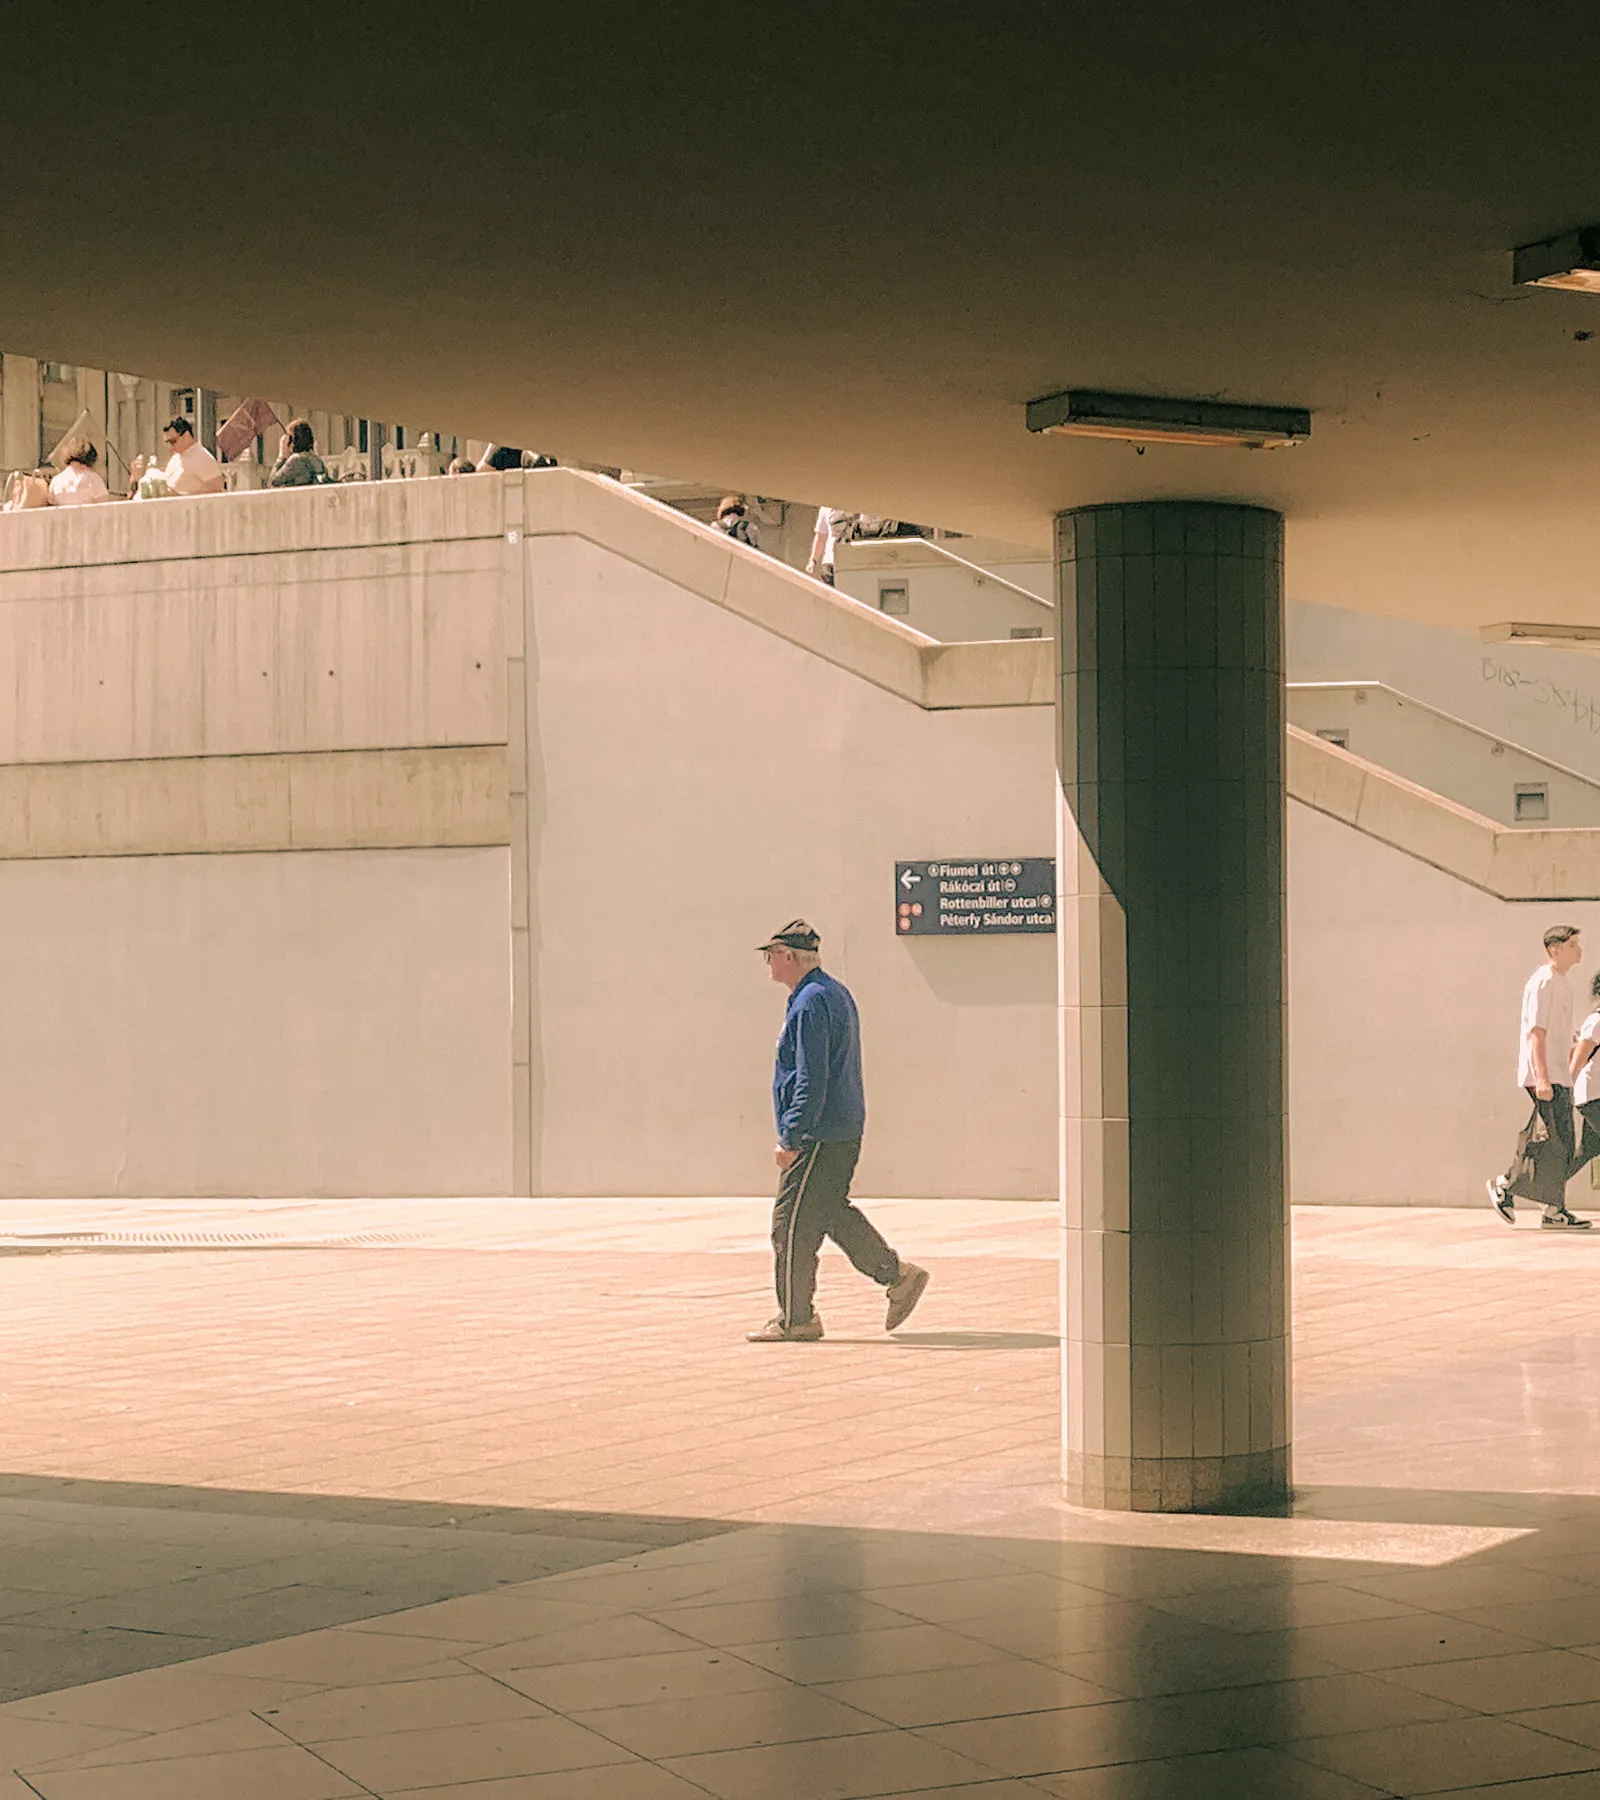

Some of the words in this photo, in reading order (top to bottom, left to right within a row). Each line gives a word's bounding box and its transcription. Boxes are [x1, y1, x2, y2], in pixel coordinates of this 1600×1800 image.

[939, 863, 979, 877] Fiumei
[981, 863, 995, 876] út
[939, 880, 985, 893] Rákóczi
[988, 879, 1001, 892] út
[939, 896, 1008, 910] Rottenbiller
[1011, 898, 1038, 909] utca
[939, 913, 981, 929] Péterfy
[983, 912, 1024, 926] Sándor
[1026, 914, 1053, 925] utca
